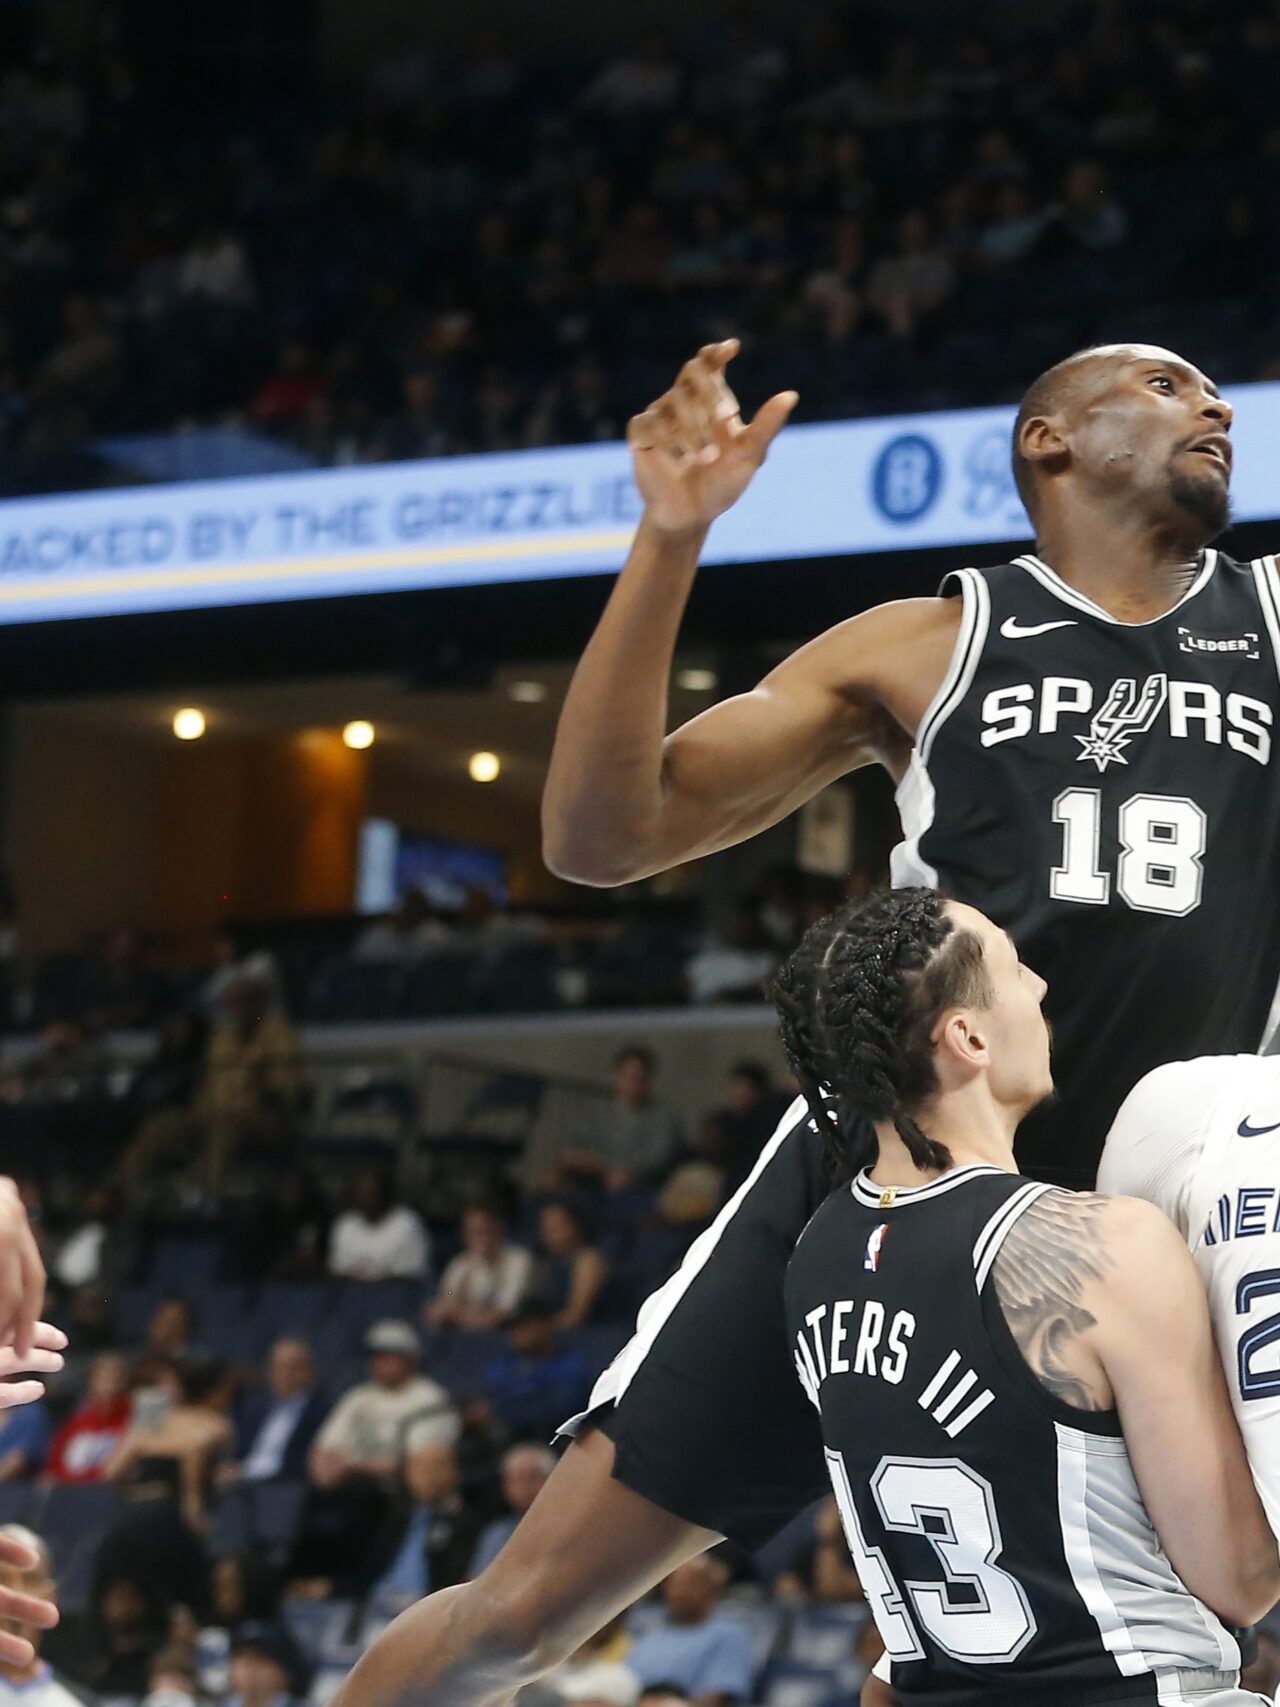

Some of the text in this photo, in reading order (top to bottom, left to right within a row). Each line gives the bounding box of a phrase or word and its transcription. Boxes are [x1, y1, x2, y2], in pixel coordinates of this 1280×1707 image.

[2, 478, 643, 570] ACKED BY THE GRIZZLIE
[1187, 636, 1250, 652] LEDGER
[980, 673, 1273, 772] SPURS
[1049, 786, 1207, 918] 18
[794, 1300, 996, 1439] TERS III
